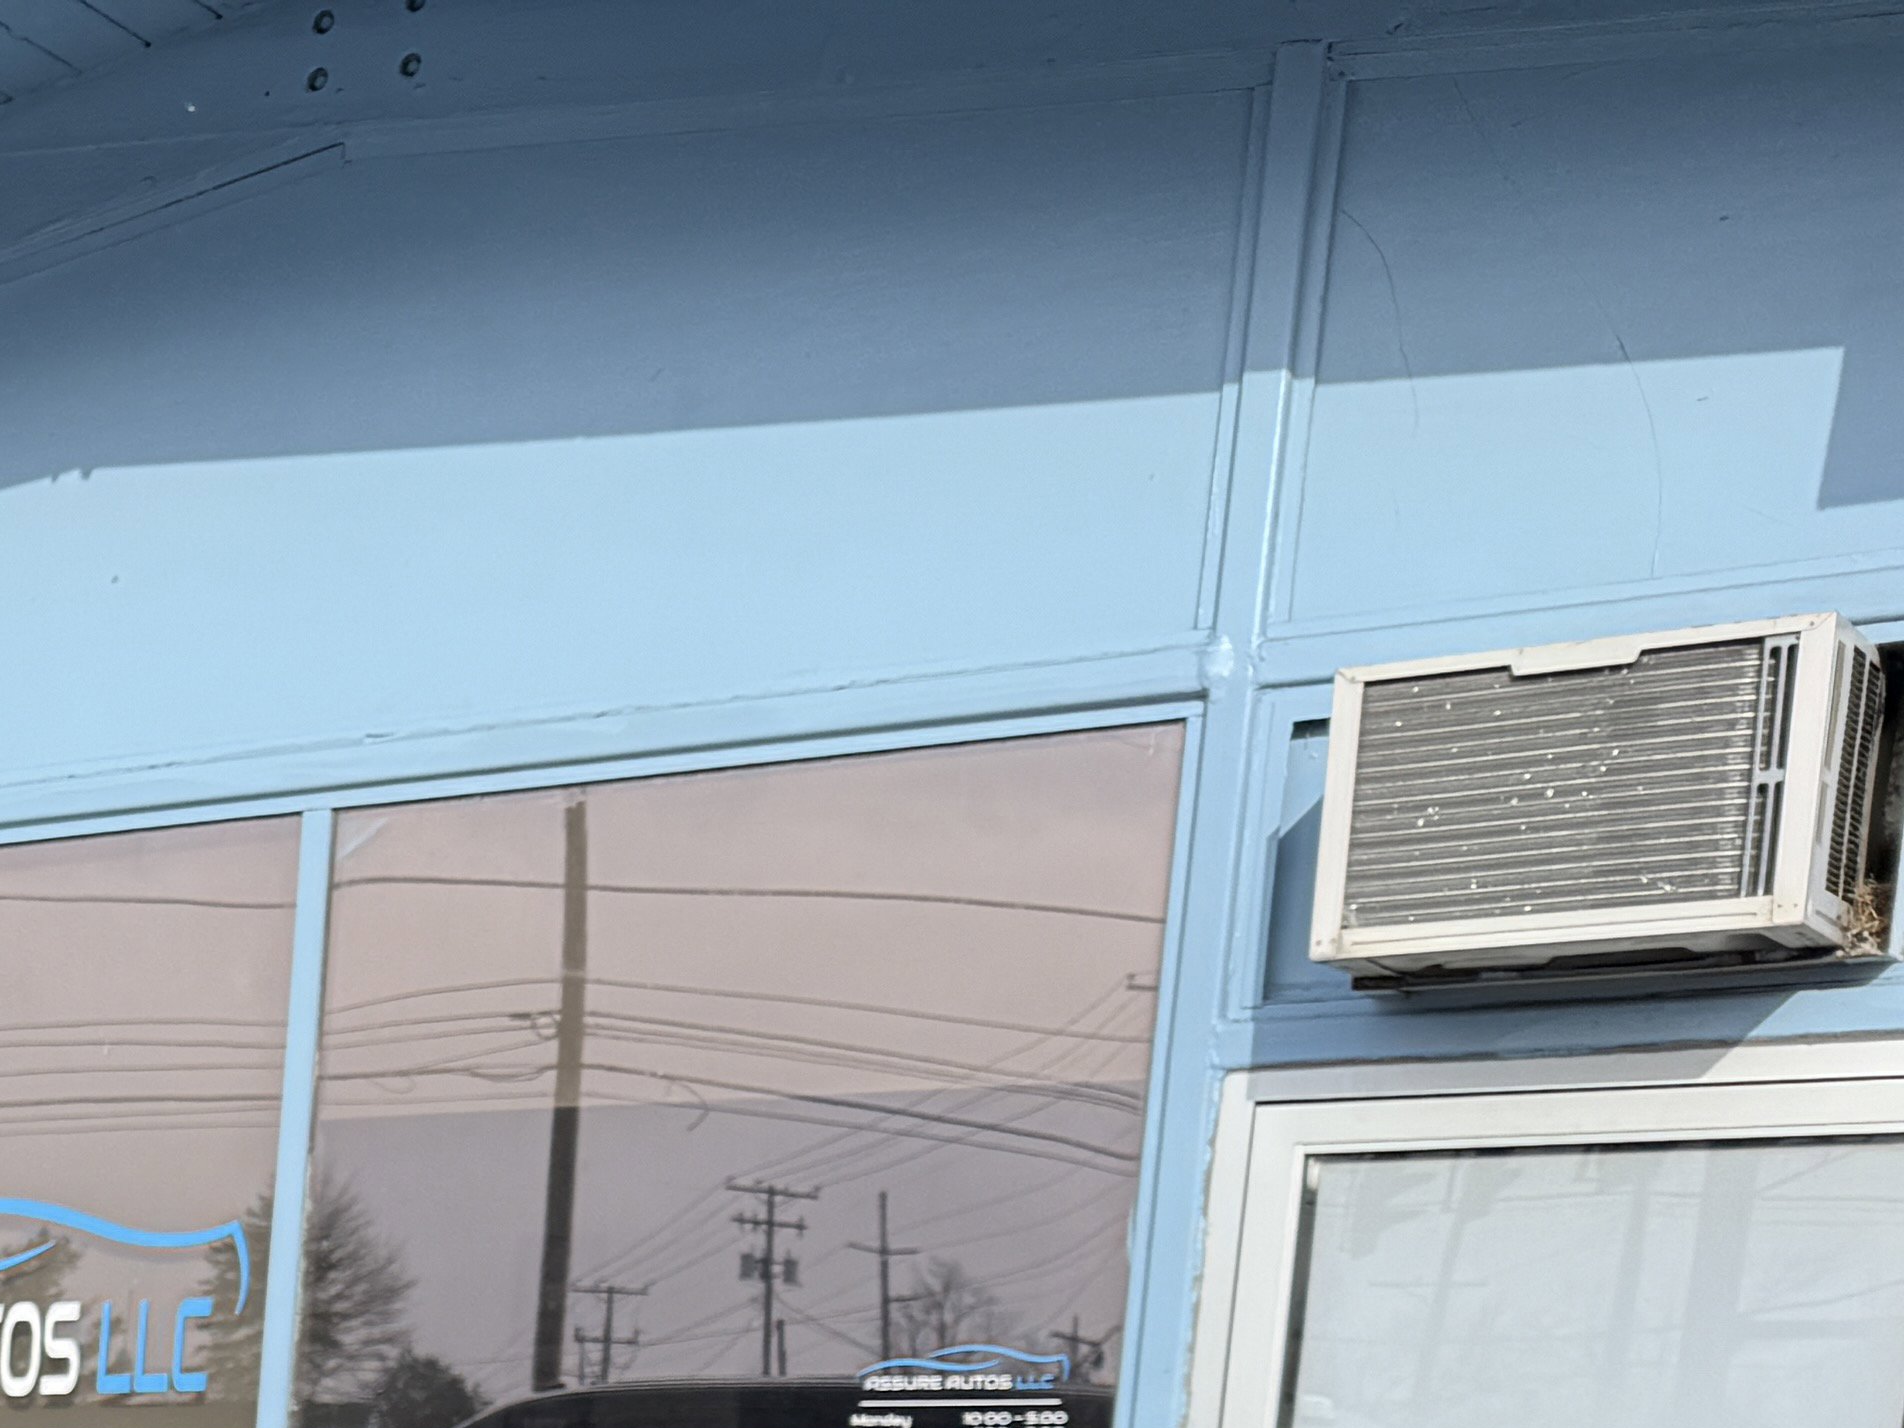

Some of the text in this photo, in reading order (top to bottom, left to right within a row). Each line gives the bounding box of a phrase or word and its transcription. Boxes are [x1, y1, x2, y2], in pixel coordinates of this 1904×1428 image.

[96, 1297, 214, 1394] LLC
[863, 1374, 1054, 1391] ASSURE AUTOS LLC
